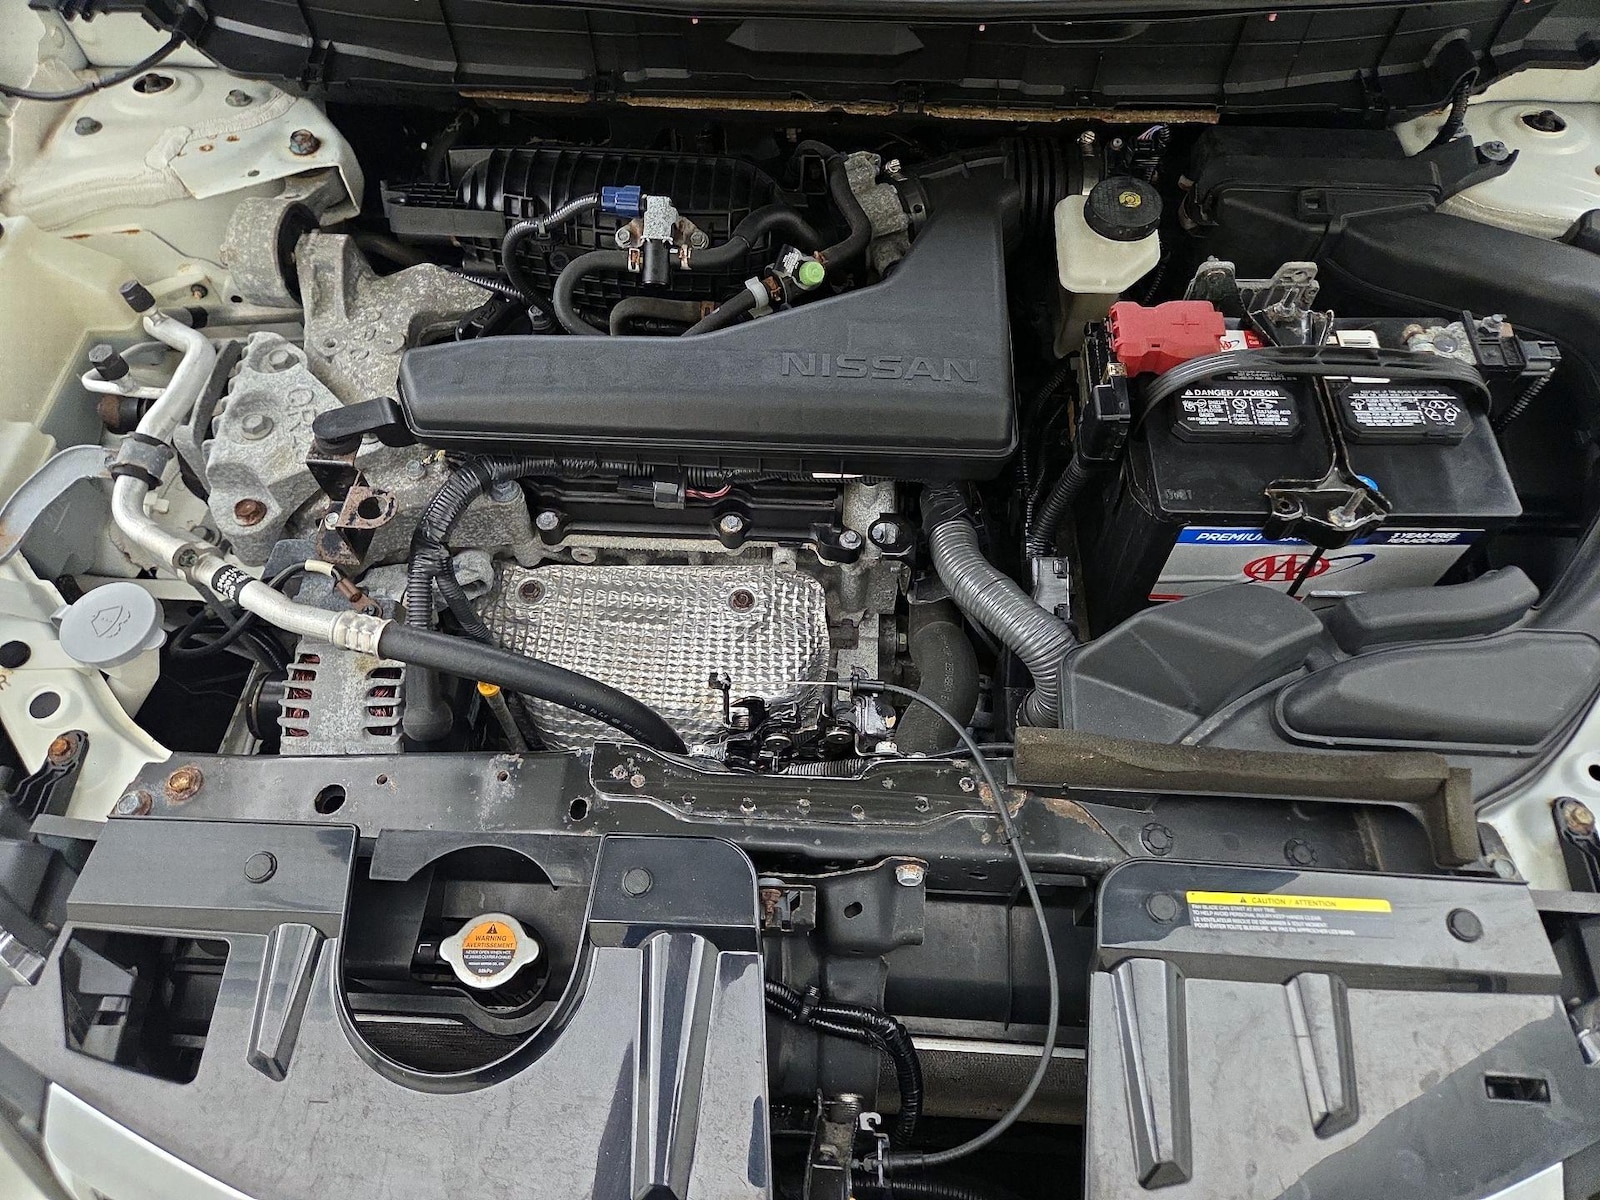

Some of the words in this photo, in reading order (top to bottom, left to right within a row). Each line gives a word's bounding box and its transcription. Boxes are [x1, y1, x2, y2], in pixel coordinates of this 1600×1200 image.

[780, 352, 979, 382] NISSAN
[1196, 532, 1263, 541] PREMIU
[1251, 897, 1286, 905] CAUTION
[1295, 899, 1337, 907] ATTENTION
